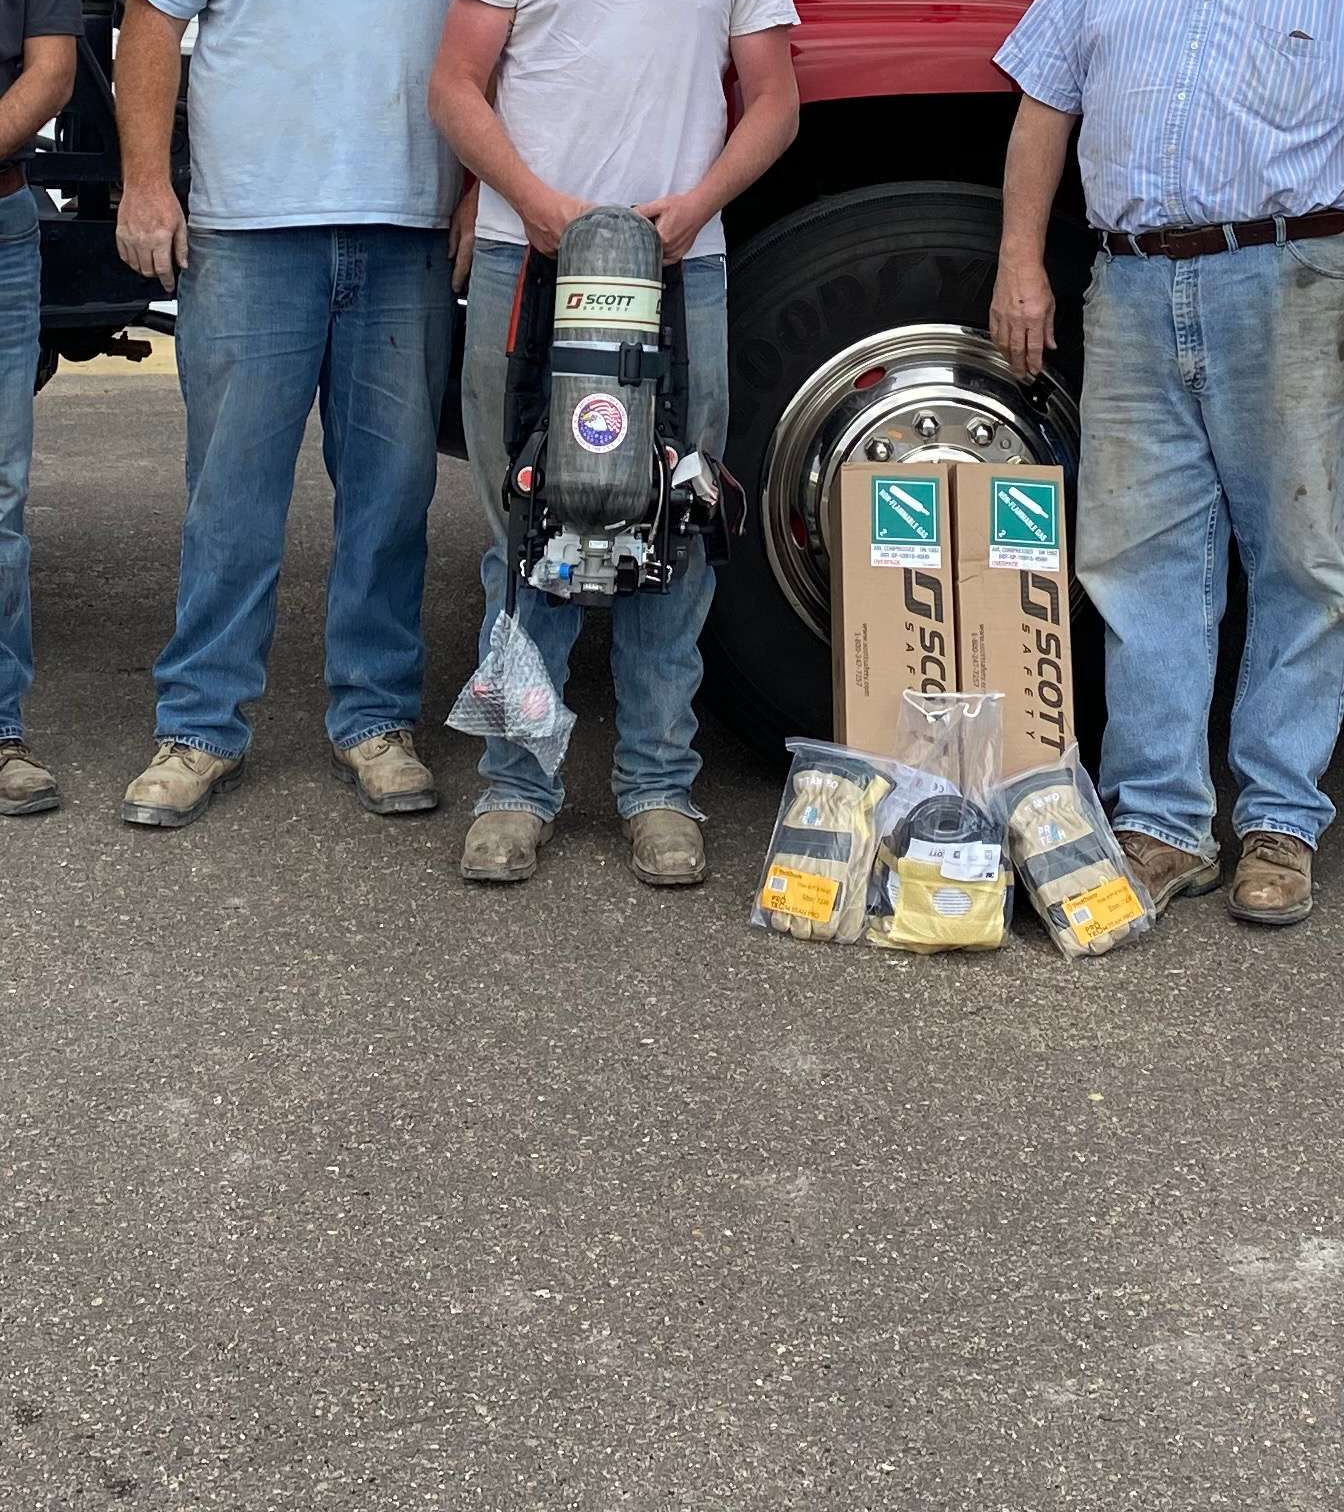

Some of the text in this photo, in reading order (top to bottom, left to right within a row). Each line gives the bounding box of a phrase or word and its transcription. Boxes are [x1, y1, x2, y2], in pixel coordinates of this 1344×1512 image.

[585, 294, 635, 307] SCOTT
[878, 488, 929, 539] NON-FLAMMABLE GAS
[997, 490, 1038, 532] NON-FLAMMABLE
[1034, 528, 1048, 542] GAS
[998, 529, 1007, 538] 2
[1021, 623, 1036, 740] SAFETY
[1035, 628, 1066, 757] SCOTT
